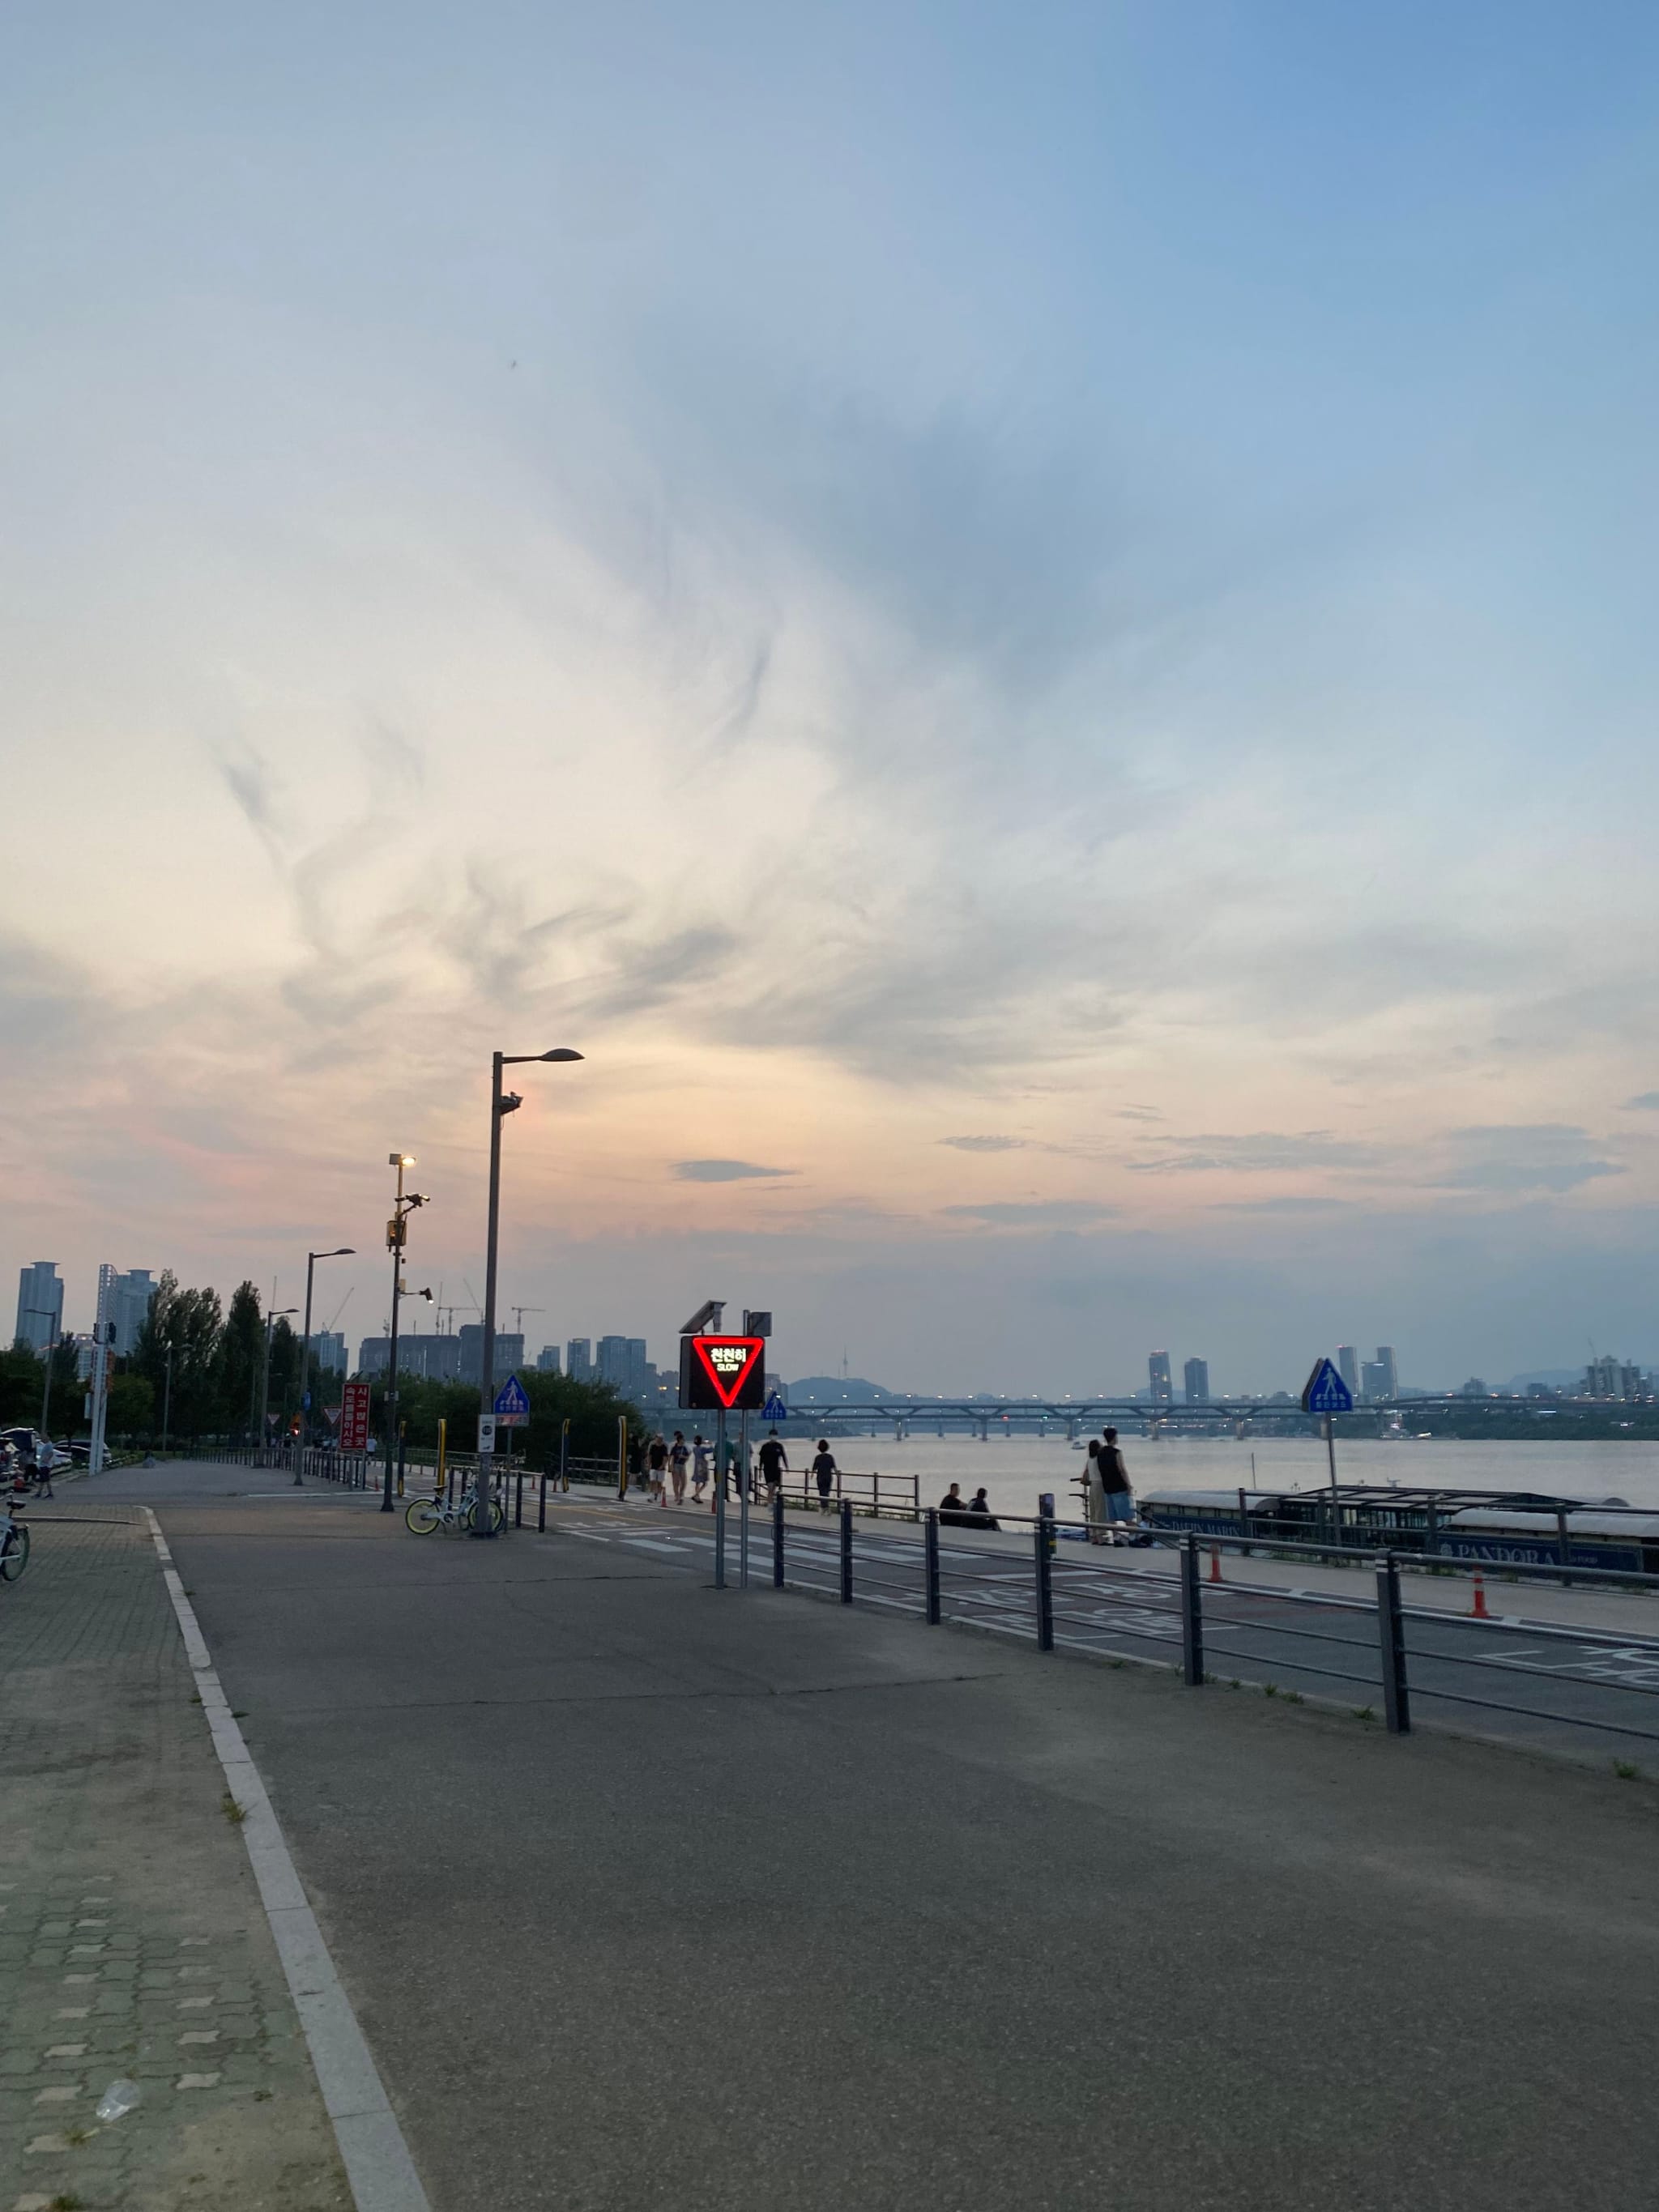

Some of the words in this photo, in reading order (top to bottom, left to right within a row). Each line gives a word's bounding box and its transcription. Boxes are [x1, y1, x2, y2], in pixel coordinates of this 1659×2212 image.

[710, 1347, 747, 1363] 천천히
[717, 1363, 740, 1371] SLOW
[1458, 1543, 1555, 1566] PANDORA
